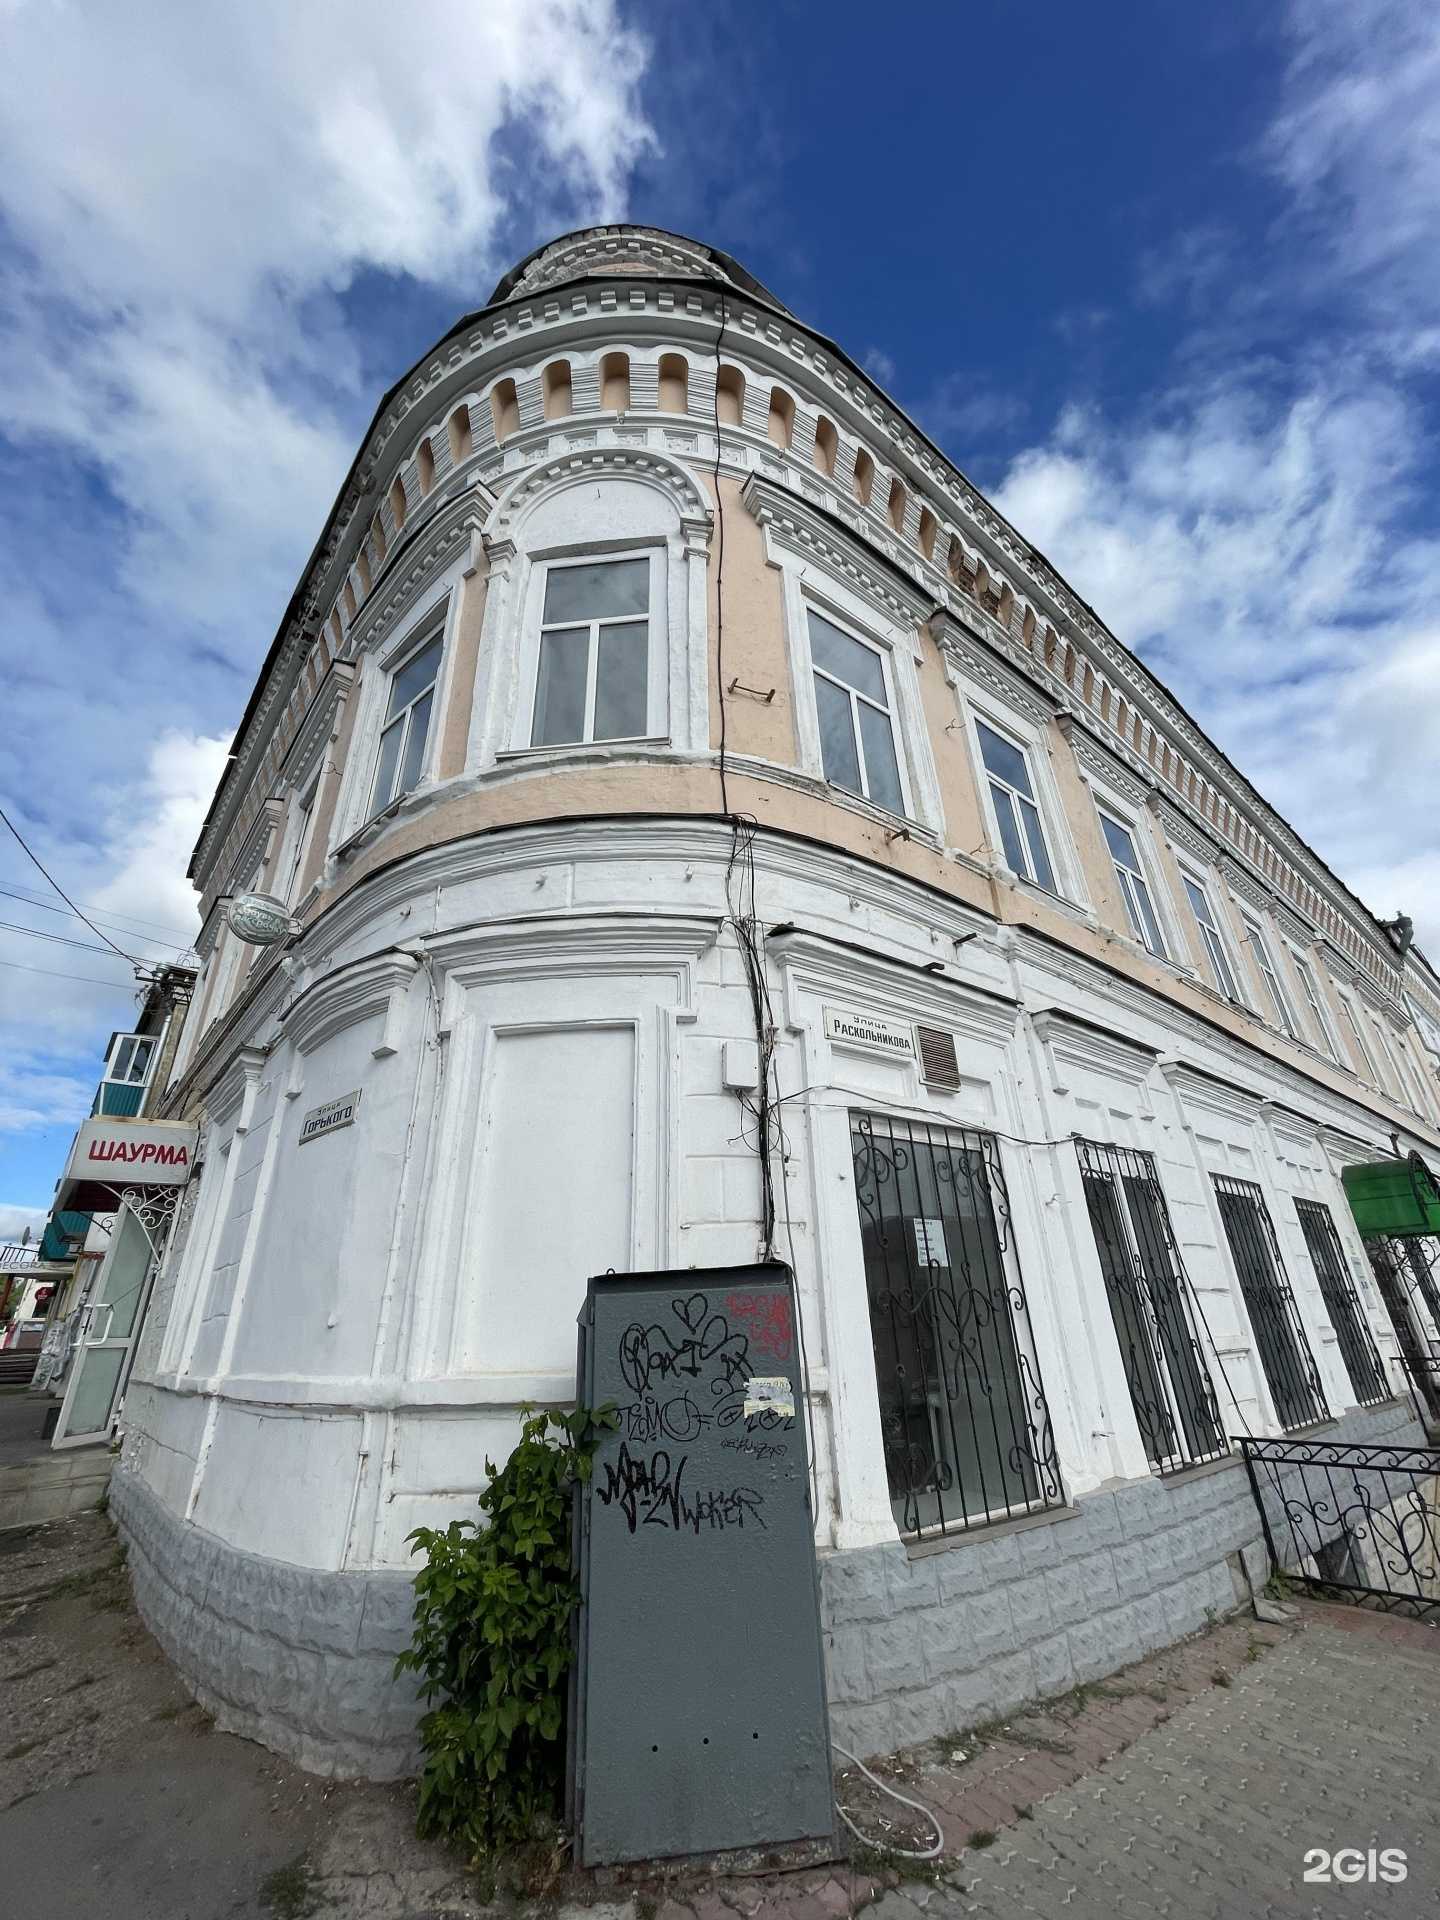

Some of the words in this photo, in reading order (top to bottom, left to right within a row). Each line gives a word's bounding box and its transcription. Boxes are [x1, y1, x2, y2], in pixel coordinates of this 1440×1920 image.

[833, 1019, 912, 1050] РАСКОЛЬНИКОВА
[303, 1105, 353, 1136] ГОРЬКОГО
[88, 1139, 189, 1166] ШАУРМА
